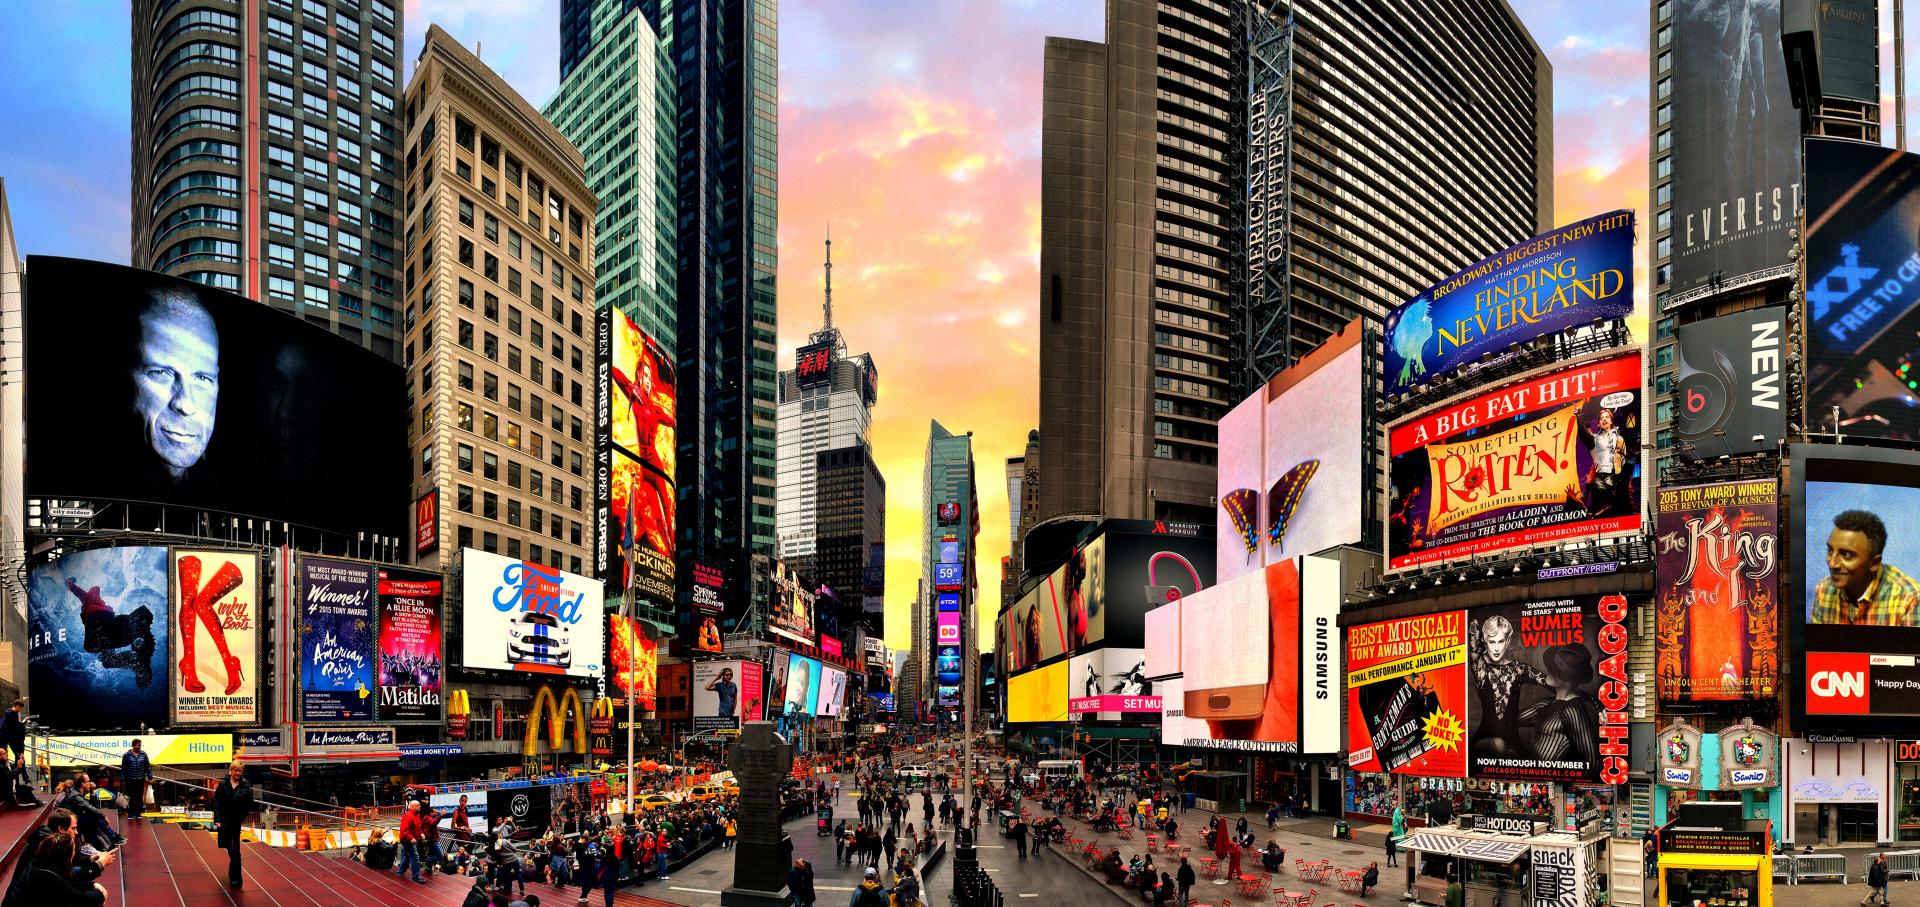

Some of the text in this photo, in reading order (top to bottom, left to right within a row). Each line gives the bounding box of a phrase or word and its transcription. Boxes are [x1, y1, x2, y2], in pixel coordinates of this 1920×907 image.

[1249, 86, 1267, 299] AMERICAN EAGLE
[1267, 113, 1285, 262] OUTFITTERS
[1686, 183, 1800, 247] EVEREST
[1433, 212, 1630, 300] BROADWAY'S BIGGEST NEW HIT!
[1485, 250, 1562, 286] MATTHEW MORRISON
[1475, 256, 1577, 312] FINDING
[1436, 269, 1624, 357] NEVERLAND
[1828, 279, 1903, 340] FREE TO
[1752, 320, 1779, 410] NEW
[1486, 388, 1530, 420] FAT
[598, 322, 608, 572] OPEN EXPRESS OPEN EXPRESS
[1447, 416, 1558, 458] SOMETHING
[1660, 483, 1776, 504] 2015 TONY AWARD WINNER!
[1660, 504, 1679, 512] BEST
[1682, 500, 1715, 510] REVIVAL
[1738, 496, 1775, 504] MUSICAL
[1442, 506, 1478, 525] BROADWAY'S
[1471, 517, 1496, 528] DIRECTOR
[1505, 506, 1548, 521] ALADDIN
[1549, 505, 1563, 513] AND
[1436, 533, 1469, 544] CO-DIRECTOR
[1478, 526, 1496, 537] THE
[1498, 521, 1524, 533] BOOK
[1542, 509, 1588, 524] MORMON
[1453, 545, 1479, 554] CORNER
[1658, 512, 1777, 585] The King
[331, 568, 368, 578] AWARD-WINNING
[307, 582, 369, 606] Winner!
[493, 564, 584, 624] Ford
[693, 584, 717, 600] SPRING
[1685, 582, 1720, 607] and
[308, 603, 318, 615] 4
[333, 607, 346, 615] TONY
[347, 608, 368, 616] AWARDS
[222, 616, 254, 630] Boots
[942, 628, 956, 636] DD
[1351, 614, 1459, 647] BEST MUSICAL!
[1521, 613, 1584, 631] RUMER
[323, 630, 337, 649] An
[1351, 636, 1458, 660] TONY AWARD WINNER
[1522, 630, 1584, 648] WILLIS
[313, 643, 365, 668] American
[1316, 617, 1327, 700] SAMSUNG
[322, 662, 354, 679] Paris
[1351, 653, 1447, 683] FINAL PERFORMANCE JANUARY
[1598, 595, 1629, 785] CHICAGO
[1734, 678, 1771, 686] THEATER
[1811, 671, 1865, 698] CNN
[179, 696, 205, 705] WINNER!
[380, 686, 440, 706] Matilda
[1090, 700, 1100, 708] FREE
[1124, 699, 1143, 708] SET
[1372, 684, 1412, 750] GENTLEMAN'S
[1374, 715, 1381, 725] A
[1437, 717, 1449, 728] NO
[322, 732, 355, 744] American
[357, 732, 374, 744] Paris
[1391, 719, 1418, 742] GUIDE
[1428, 726, 1454, 742] JOKE!
[74, 740, 120, 748] Mechanical
[189, 742, 224, 752] Hilton
[1183, 738, 1297, 754] AMERICAN EAGLE OUTFITTERS
[1483, 767, 1582, 778] CHICAGOTHEMUSICAL.COM
[1498, 759, 1536, 767] THROUGH
[1538, 760, 1584, 769] NOVEMBER
[1421, 778, 1462, 792] GRAND
[1490, 782, 1531, 796] SLAM
[513, 804, 527, 814] NY
[1487, 817, 1530, 832] HOT DOGS
[1534, 848, 1575, 866] snack
[1560, 868, 1576, 896] BOX
